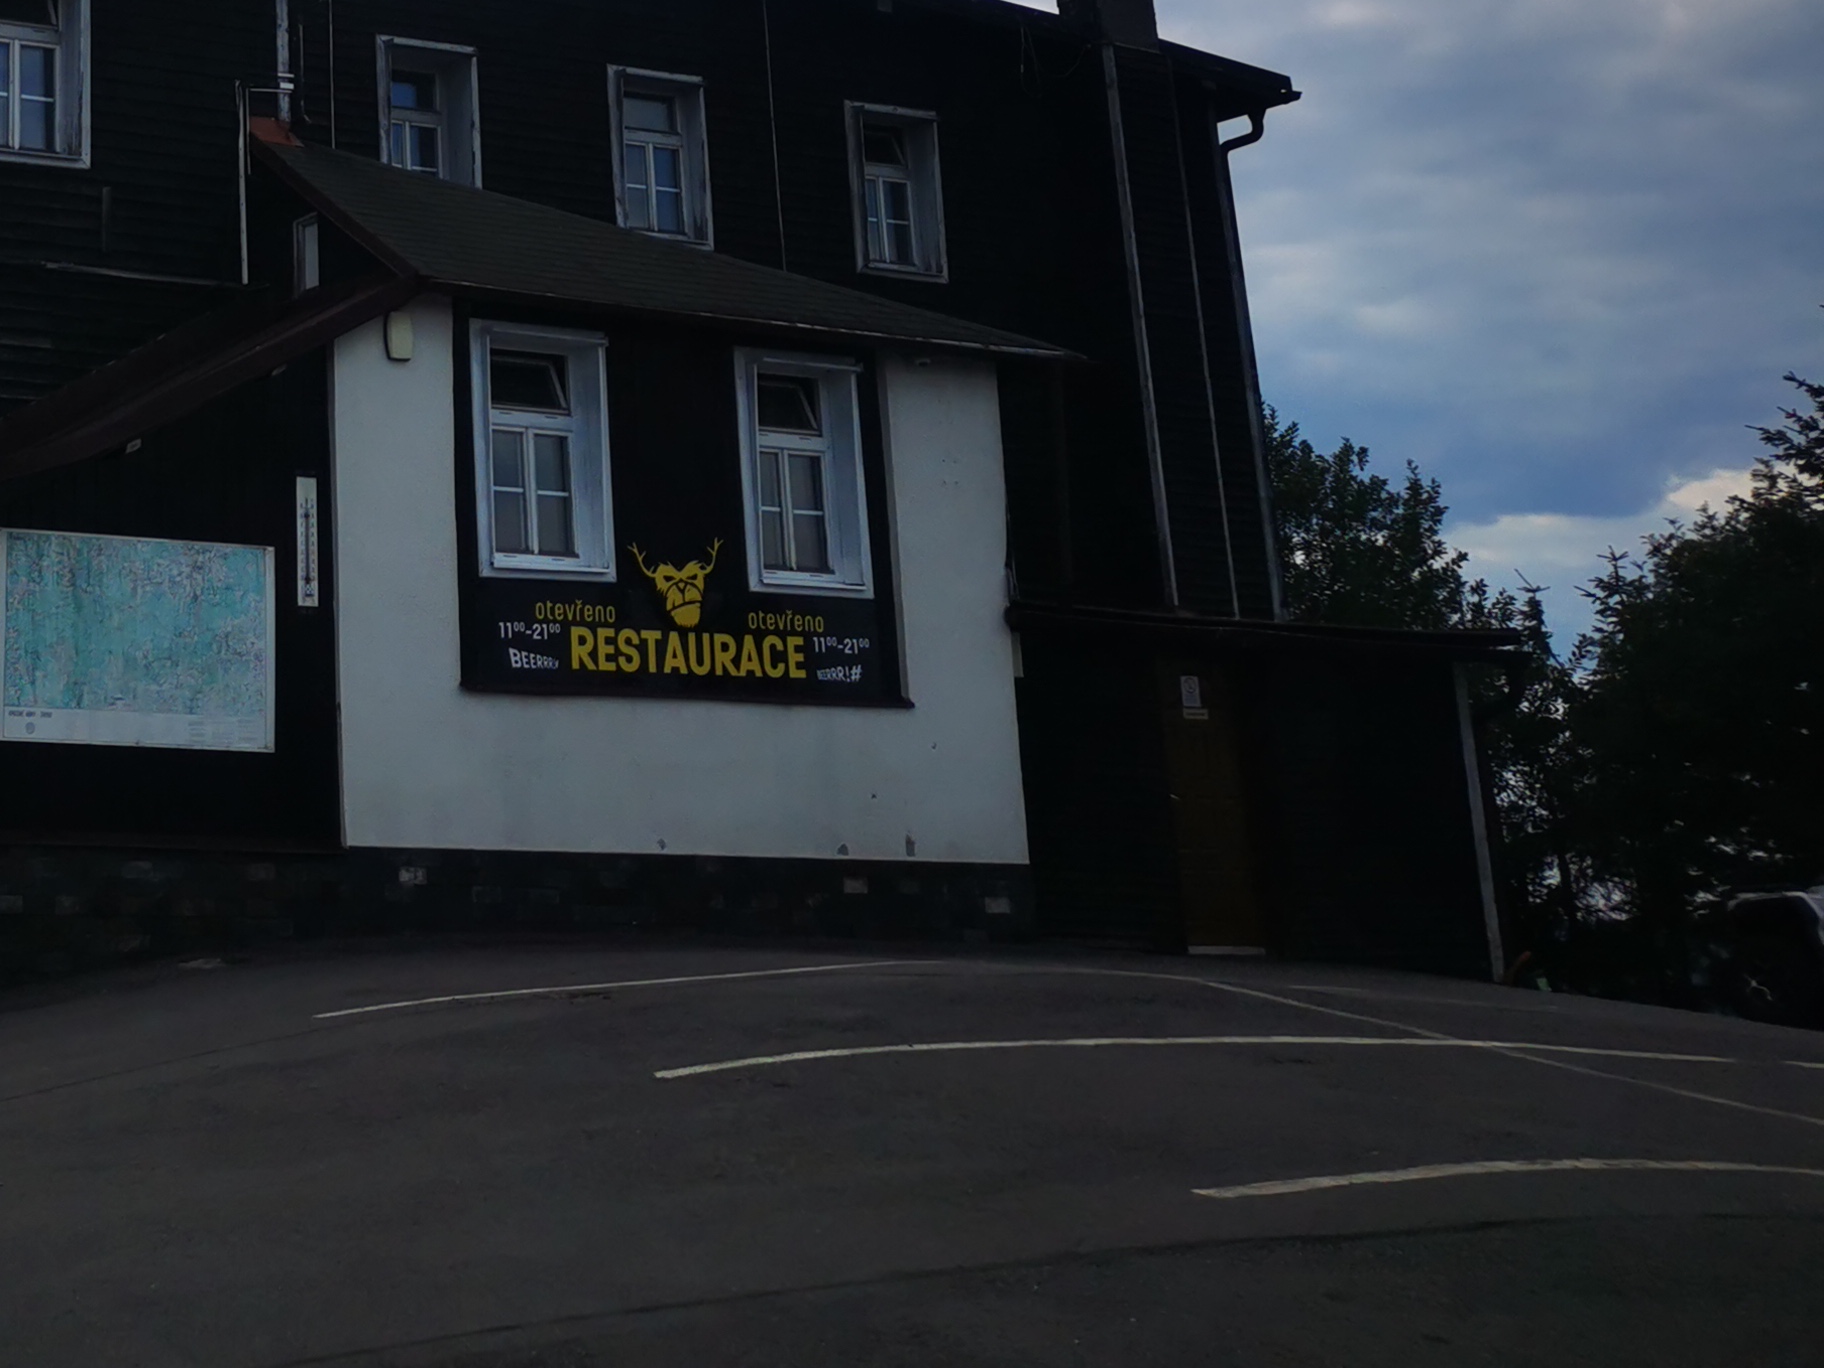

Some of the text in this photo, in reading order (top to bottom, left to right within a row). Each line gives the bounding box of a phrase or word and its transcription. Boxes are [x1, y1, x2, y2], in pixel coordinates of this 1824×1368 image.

[534, 598, 617, 624] otevřeno
[747, 608, 825, 634] otevřeno
[569, 625, 808, 680] RESTAURACE
